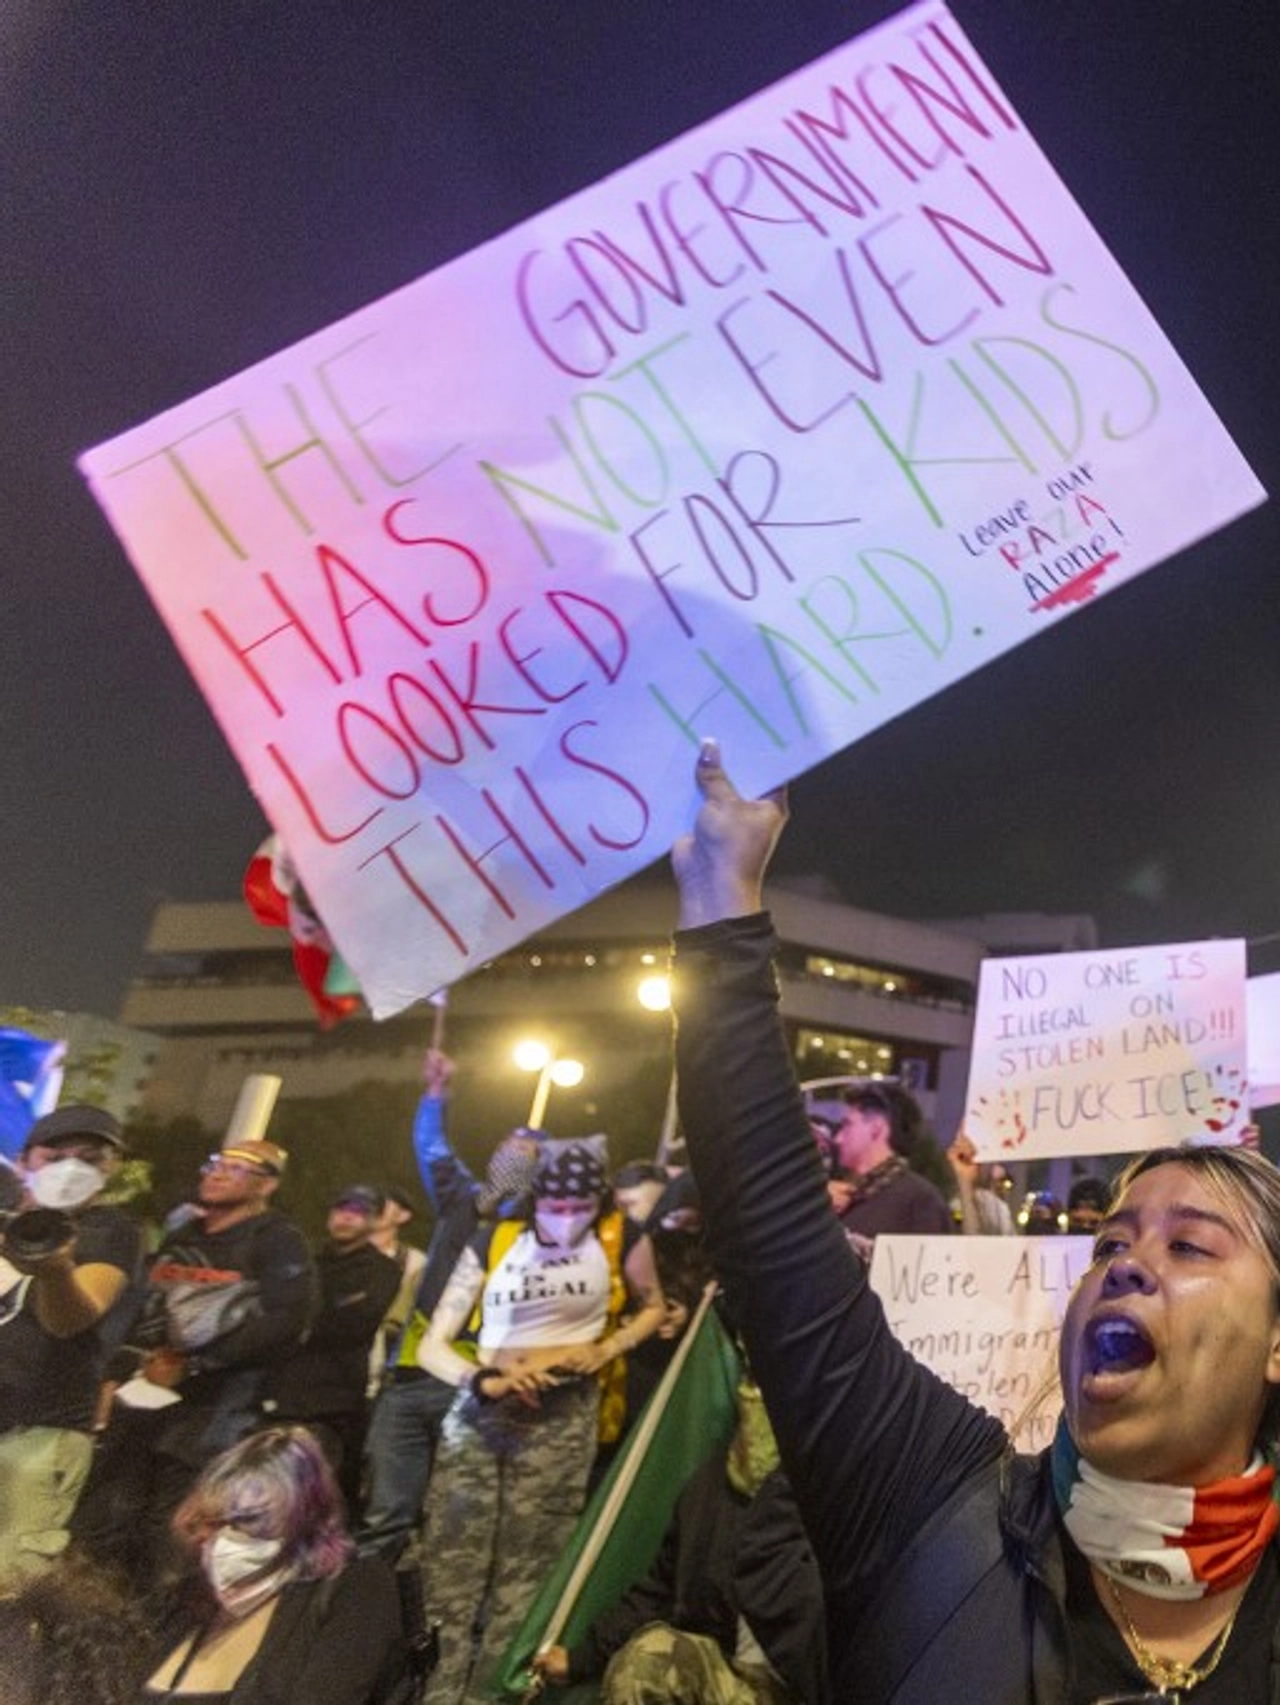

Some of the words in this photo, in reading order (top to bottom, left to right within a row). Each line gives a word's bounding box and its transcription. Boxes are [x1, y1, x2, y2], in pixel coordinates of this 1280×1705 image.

[105, 331, 466, 560] THE
[515, 14, 1017, 379] GOVERNMENT
[202, 498, 489, 718] HAS
[478, 331, 718, 568] NOT
[716, 164, 1054, 434] EVEN
[1046, 463, 1094, 501] our
[267, 590, 629, 844] LOOKED
[629, 450, 861, 638] FOR
[857, 283, 1160, 529] KIDS
[999, 494, 1106, 571] RAZA
[357, 720, 649, 956] THIS
[647, 547, 984, 751] HARD.
[1002, 966, 1046, 1000] NO
[1084, 959, 1140, 989] ONE
[1167, 952, 1207, 980] IS
[996, 1005, 1091, 1040] ILLEGAL
[1130, 992, 1174, 1018] ON
[998, 1036, 1103, 1077] STOLEN
[1122, 1007, 1236, 1055] LAND!!!
[1032, 1083, 1121, 1130] FUCK
[890, 1319, 1060, 1374] Immigran
[948, 1369, 1031, 1398] tolen
